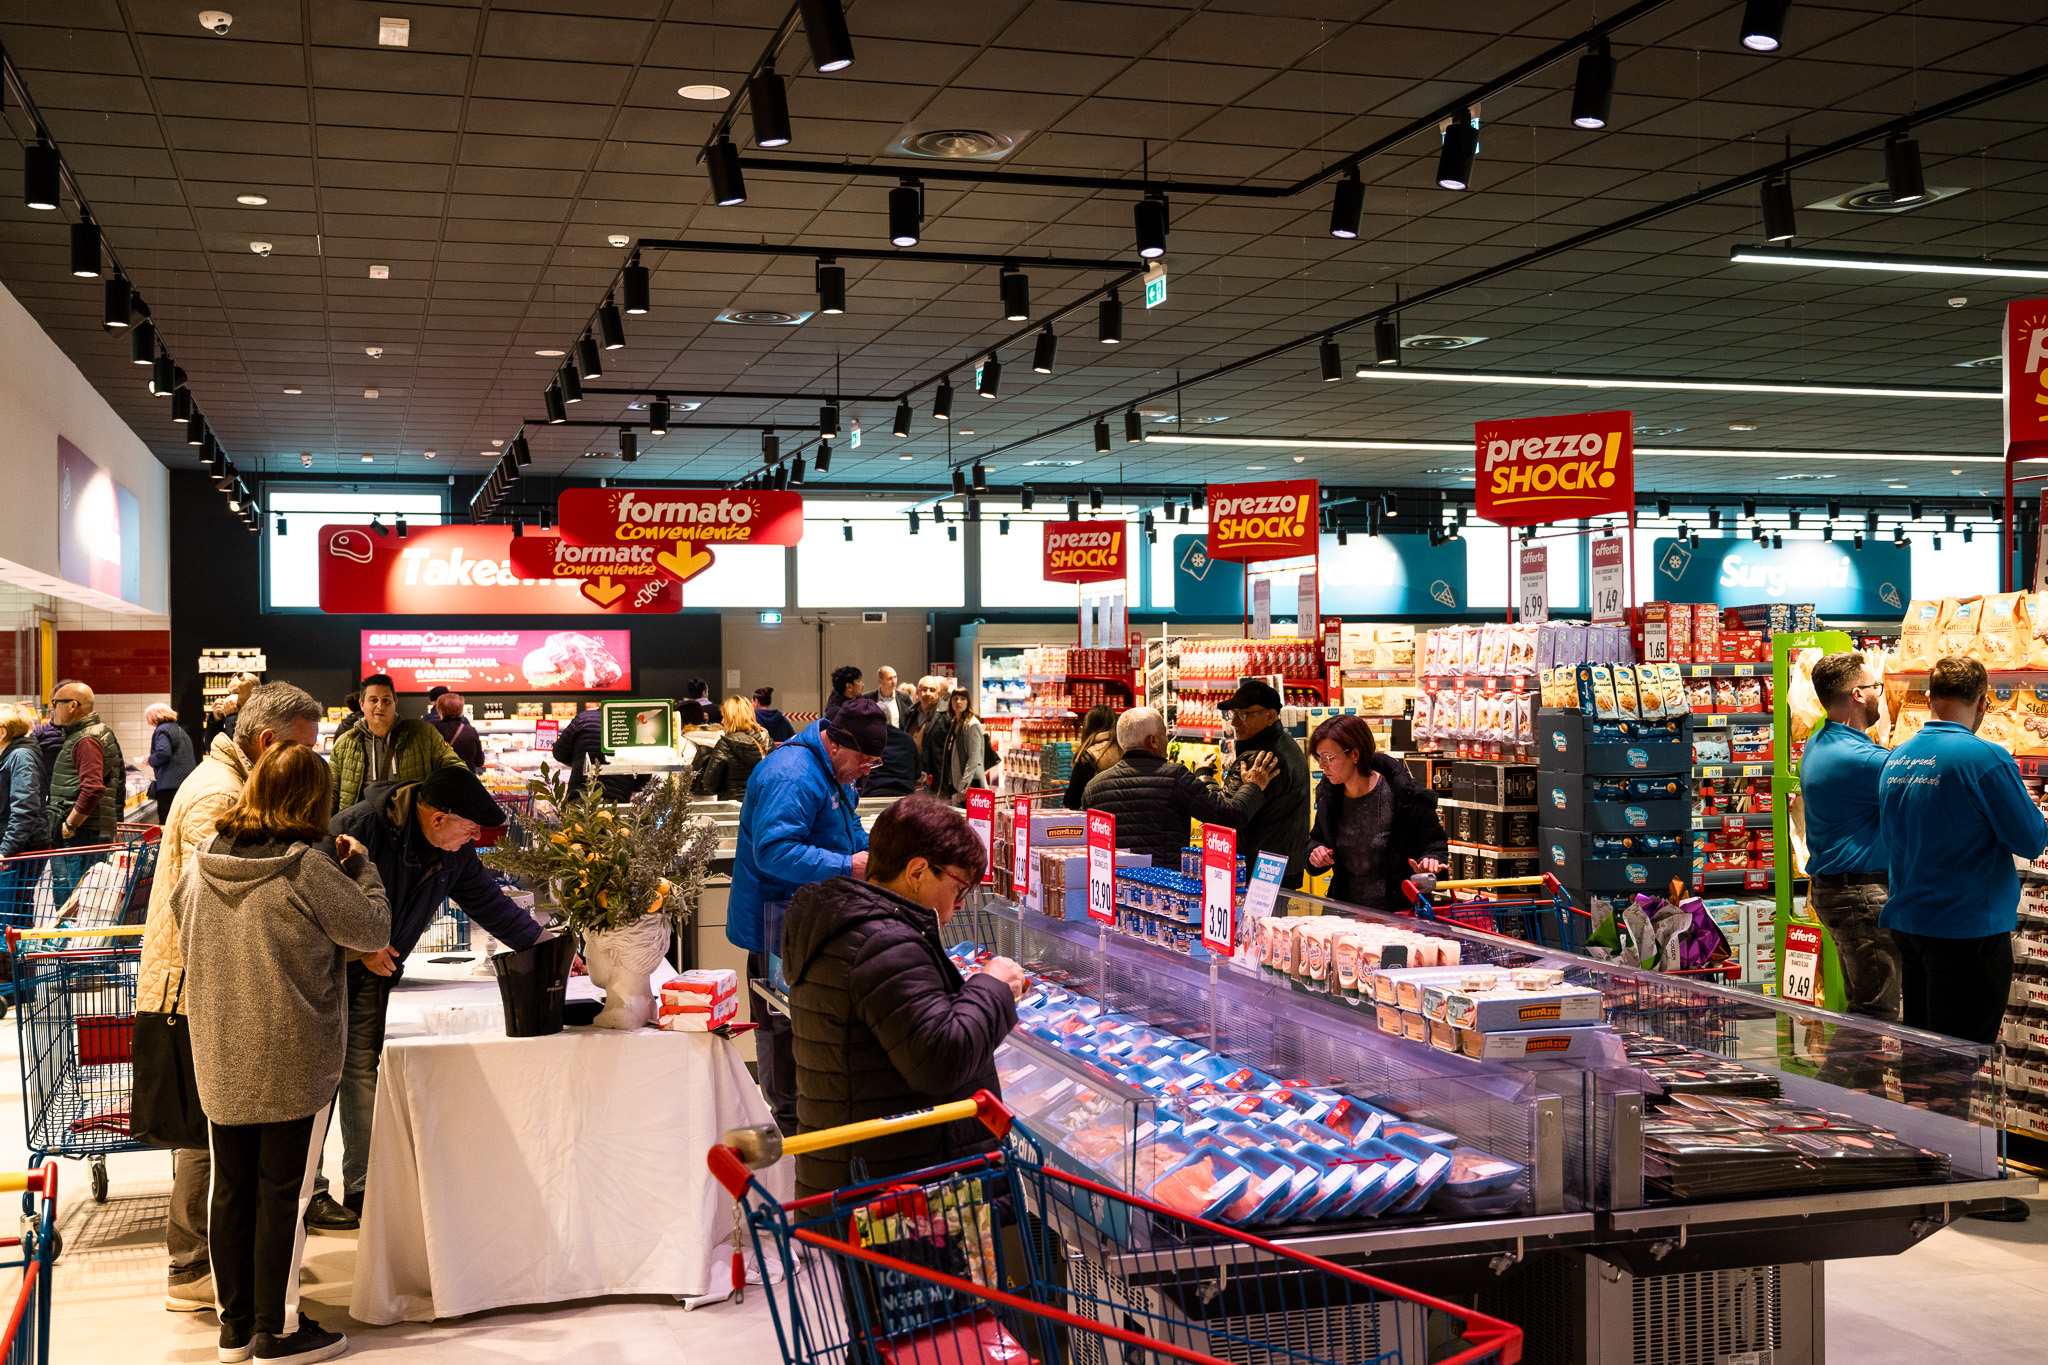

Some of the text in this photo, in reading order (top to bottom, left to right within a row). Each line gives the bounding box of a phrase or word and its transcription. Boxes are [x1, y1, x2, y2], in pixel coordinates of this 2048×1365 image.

[1484, 432, 1603, 472] prezzo
[1490, 432, 1622, 494] SHOCK!
[618, 492, 753, 523] formato
[1213, 494, 1296, 523] prezzo
[1217, 494, 1310, 540] SHOCK!
[615, 522, 752, 542] Conveniente
[1047, 531, 1111, 554] prezzo
[1050, 531, 1121, 568] SHOCK!
[1522, 552, 1544, 564] offerta
[1596, 543, 1619, 557] offerta
[552, 562, 657, 577] Conveniente
[1719, 554, 1851, 597] Surgelati
[1524, 595, 1542, 618] 6,99
[1597, 589, 1618, 614] 1,49
[1326, 647, 1338, 660] 2,79
[1649, 641, 1665, 658] 1,65
[387, 658, 434, 668] GENUINA.
[2026, 703, 2048, 714] Stell
[971, 795, 990, 808] offerta
[1091, 818, 1110, 836] offerta
[1208, 833, 1230, 854] offerta
[1091, 878, 1111, 910] 13,90
[1209, 904, 1228, 940] 3,90
[1790, 928, 1817, 943] offerta
[1789, 974, 1810, 997] 9,49
[1527, 1039, 1569, 1050] marAzur
